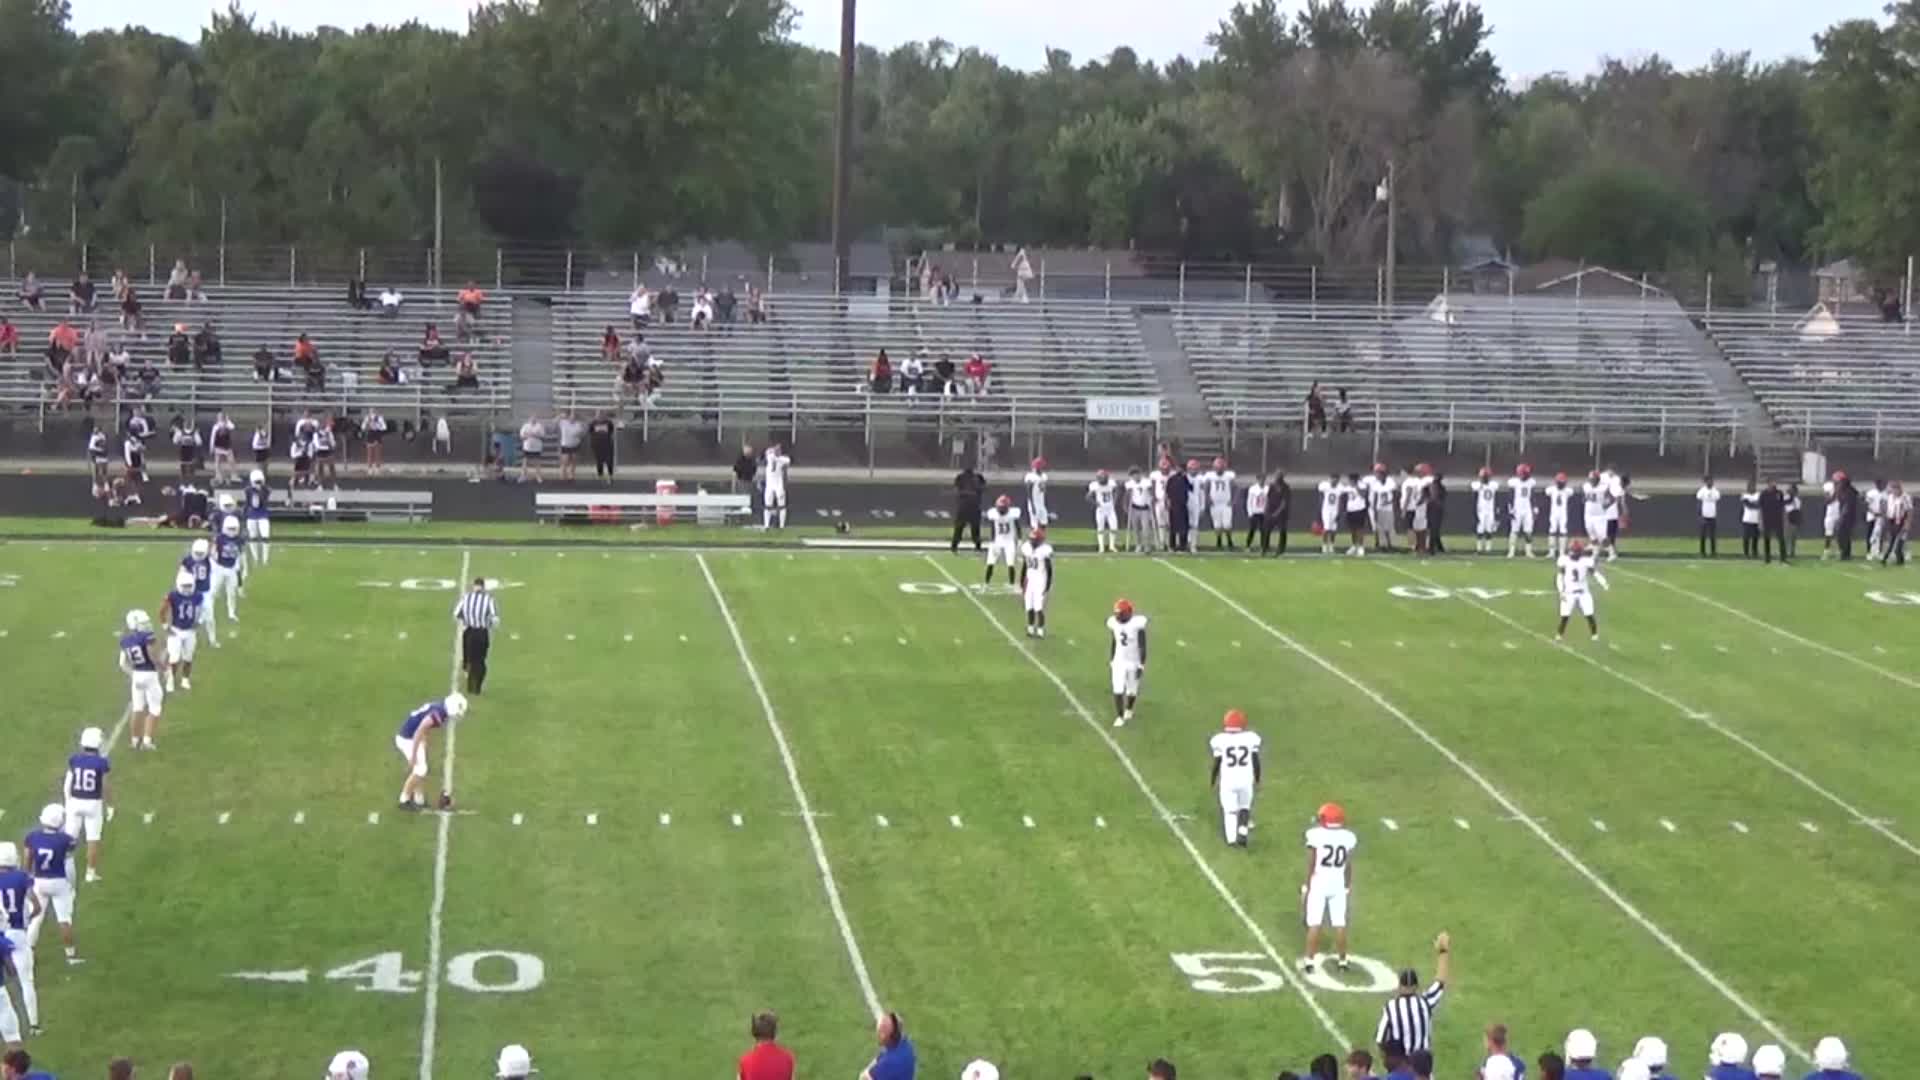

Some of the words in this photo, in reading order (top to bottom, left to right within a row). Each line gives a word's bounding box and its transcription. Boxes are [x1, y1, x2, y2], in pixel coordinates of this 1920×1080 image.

[1119, 632, 1129, 647] 2
[1226, 746, 1249, 767] 52
[73, 767, 96, 792] 16
[37, 848, 54, 871] 7
[1321, 844, 1347, 868] 20
[324, 949, 546, 994] 40
[1170, 951, 1400, 994] 50
